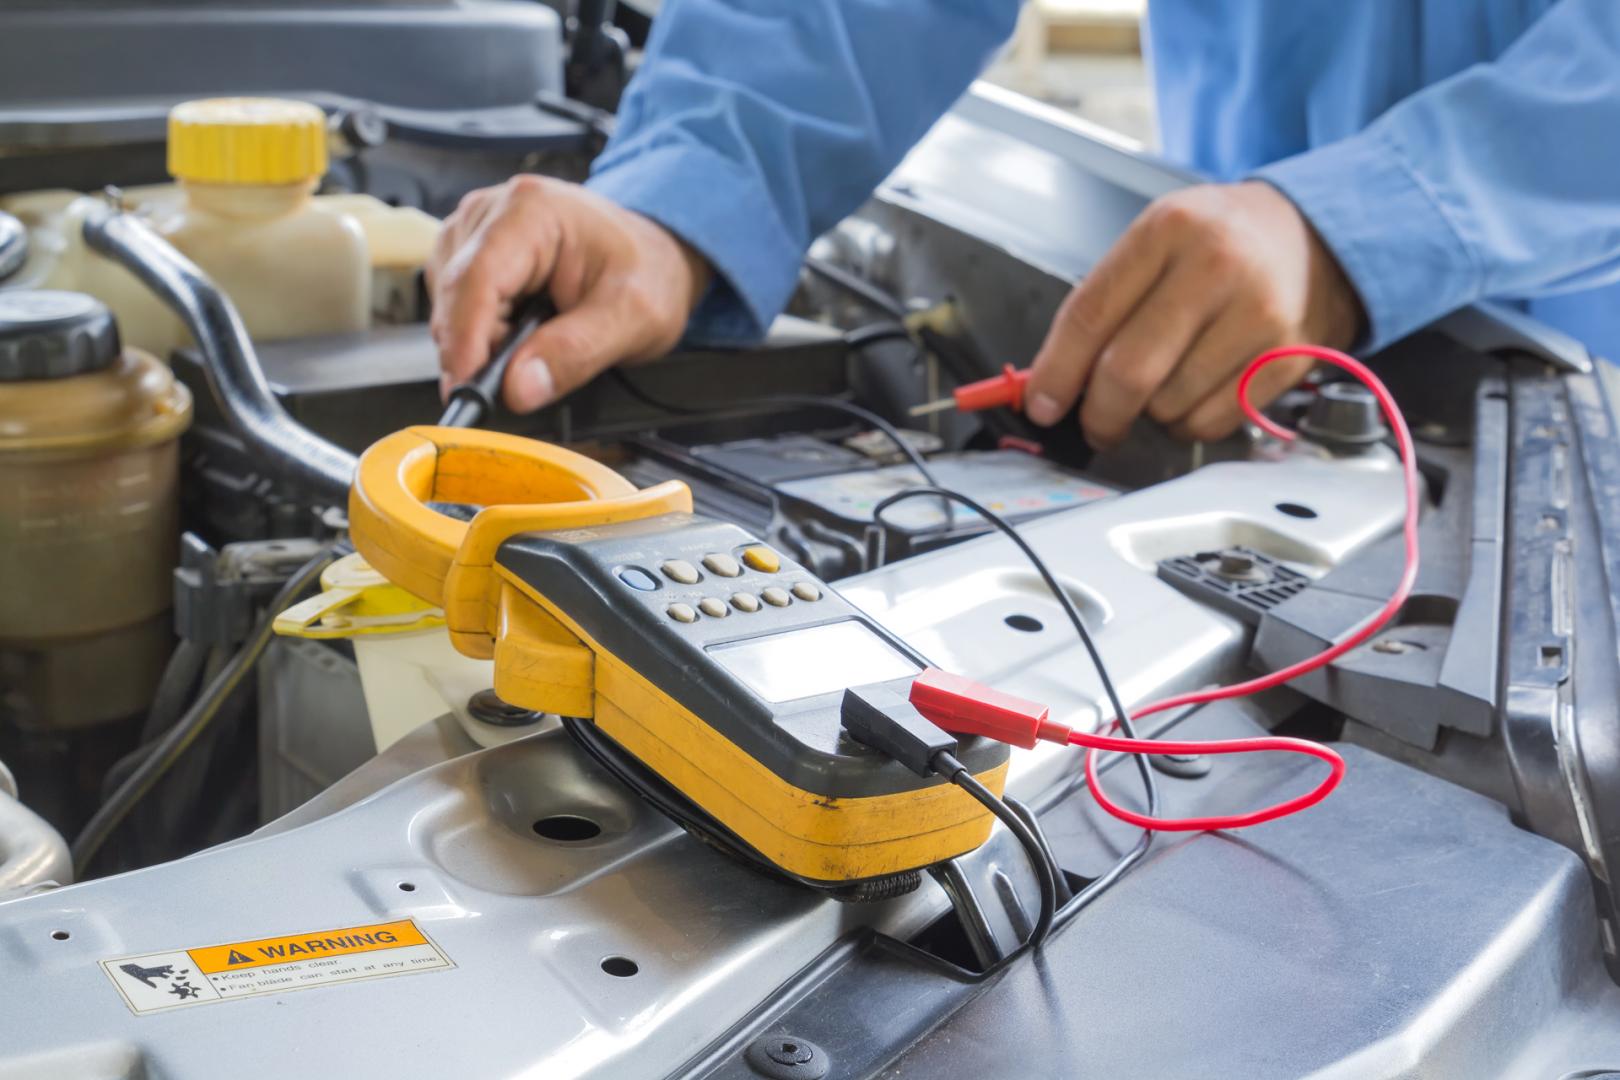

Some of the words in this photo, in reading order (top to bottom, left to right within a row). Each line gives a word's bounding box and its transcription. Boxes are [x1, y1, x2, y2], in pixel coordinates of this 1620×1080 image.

[257, 931, 398, 959] WARNING
[221, 971, 256, 982] Keep
[262, 964, 302, 975] hands
[229, 982, 255, 991] Fan
[256, 976, 293, 987] blade
[299, 972, 324, 980] can
[329, 966, 358, 976] start
[382, 960, 404, 969] any
